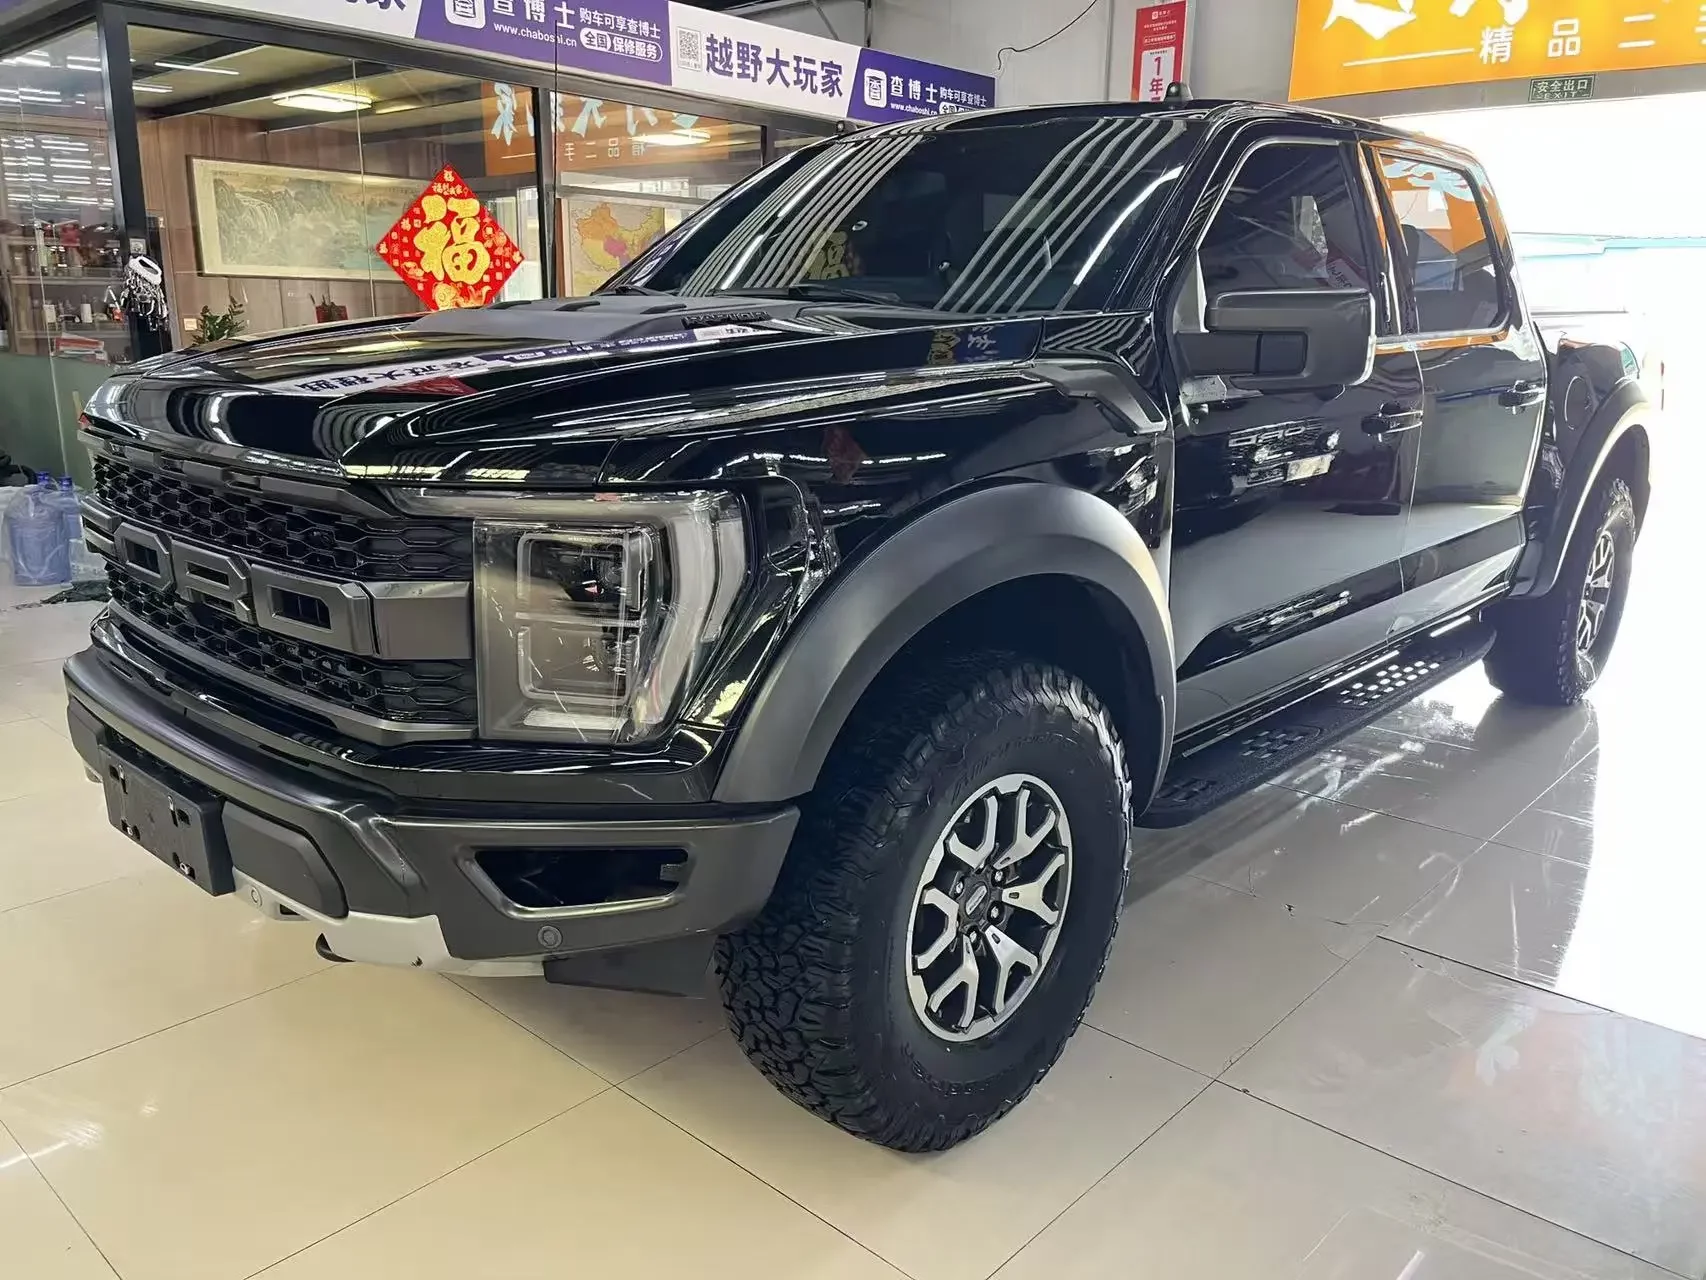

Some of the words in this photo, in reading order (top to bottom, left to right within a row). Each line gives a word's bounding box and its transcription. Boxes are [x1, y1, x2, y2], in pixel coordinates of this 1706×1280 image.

[580, 7, 661, 39] 购车可享查博士
[585, 31, 608, 49] 全国
[613, 36, 657, 60] 保修服务
[706, 34, 843, 98] 越野大玩家
[1149, 56, 1163, 101] 1年
[890, 76, 938, 104] 查博士
[940, 87, 987, 108] 购车可享查博士
[1538, 80, 1588, 93] 安全出口
[1544, 91, 1577, 100] EXIT
[413, 194, 491, 286] 福
